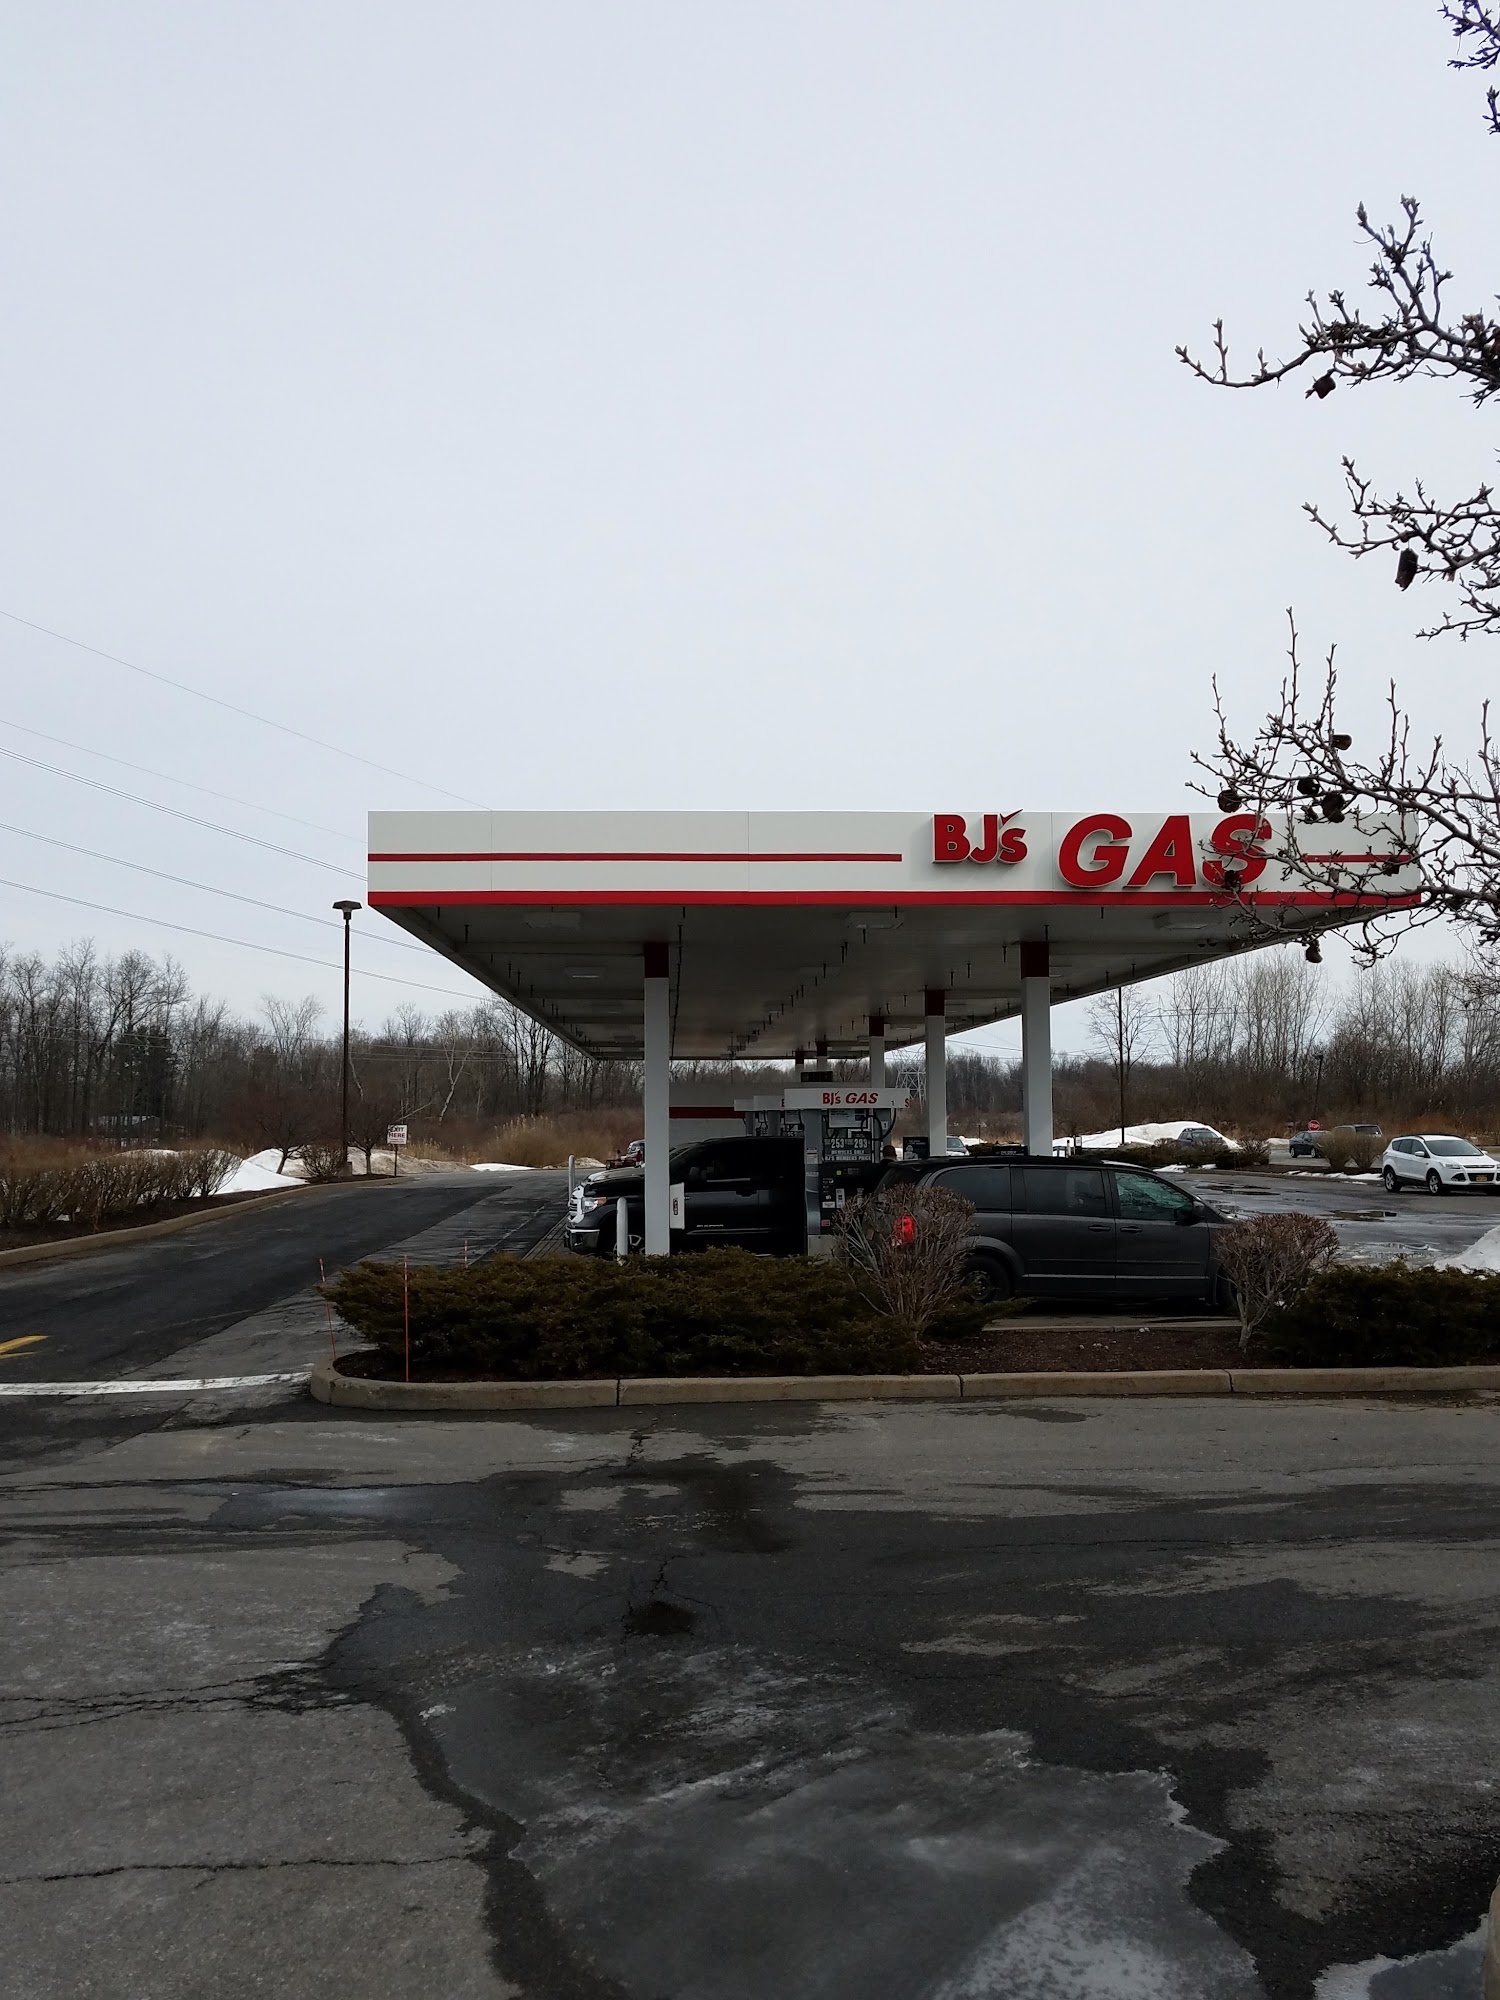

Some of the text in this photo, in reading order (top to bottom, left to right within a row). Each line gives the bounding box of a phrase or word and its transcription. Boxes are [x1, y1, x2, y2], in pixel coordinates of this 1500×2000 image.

[932, 808, 1273, 888] BJ's GAS
[845, 1092, 879, 1104] GAS
[830, 1138, 845, 1148] 253
[854, 1138, 868, 1148] 293
